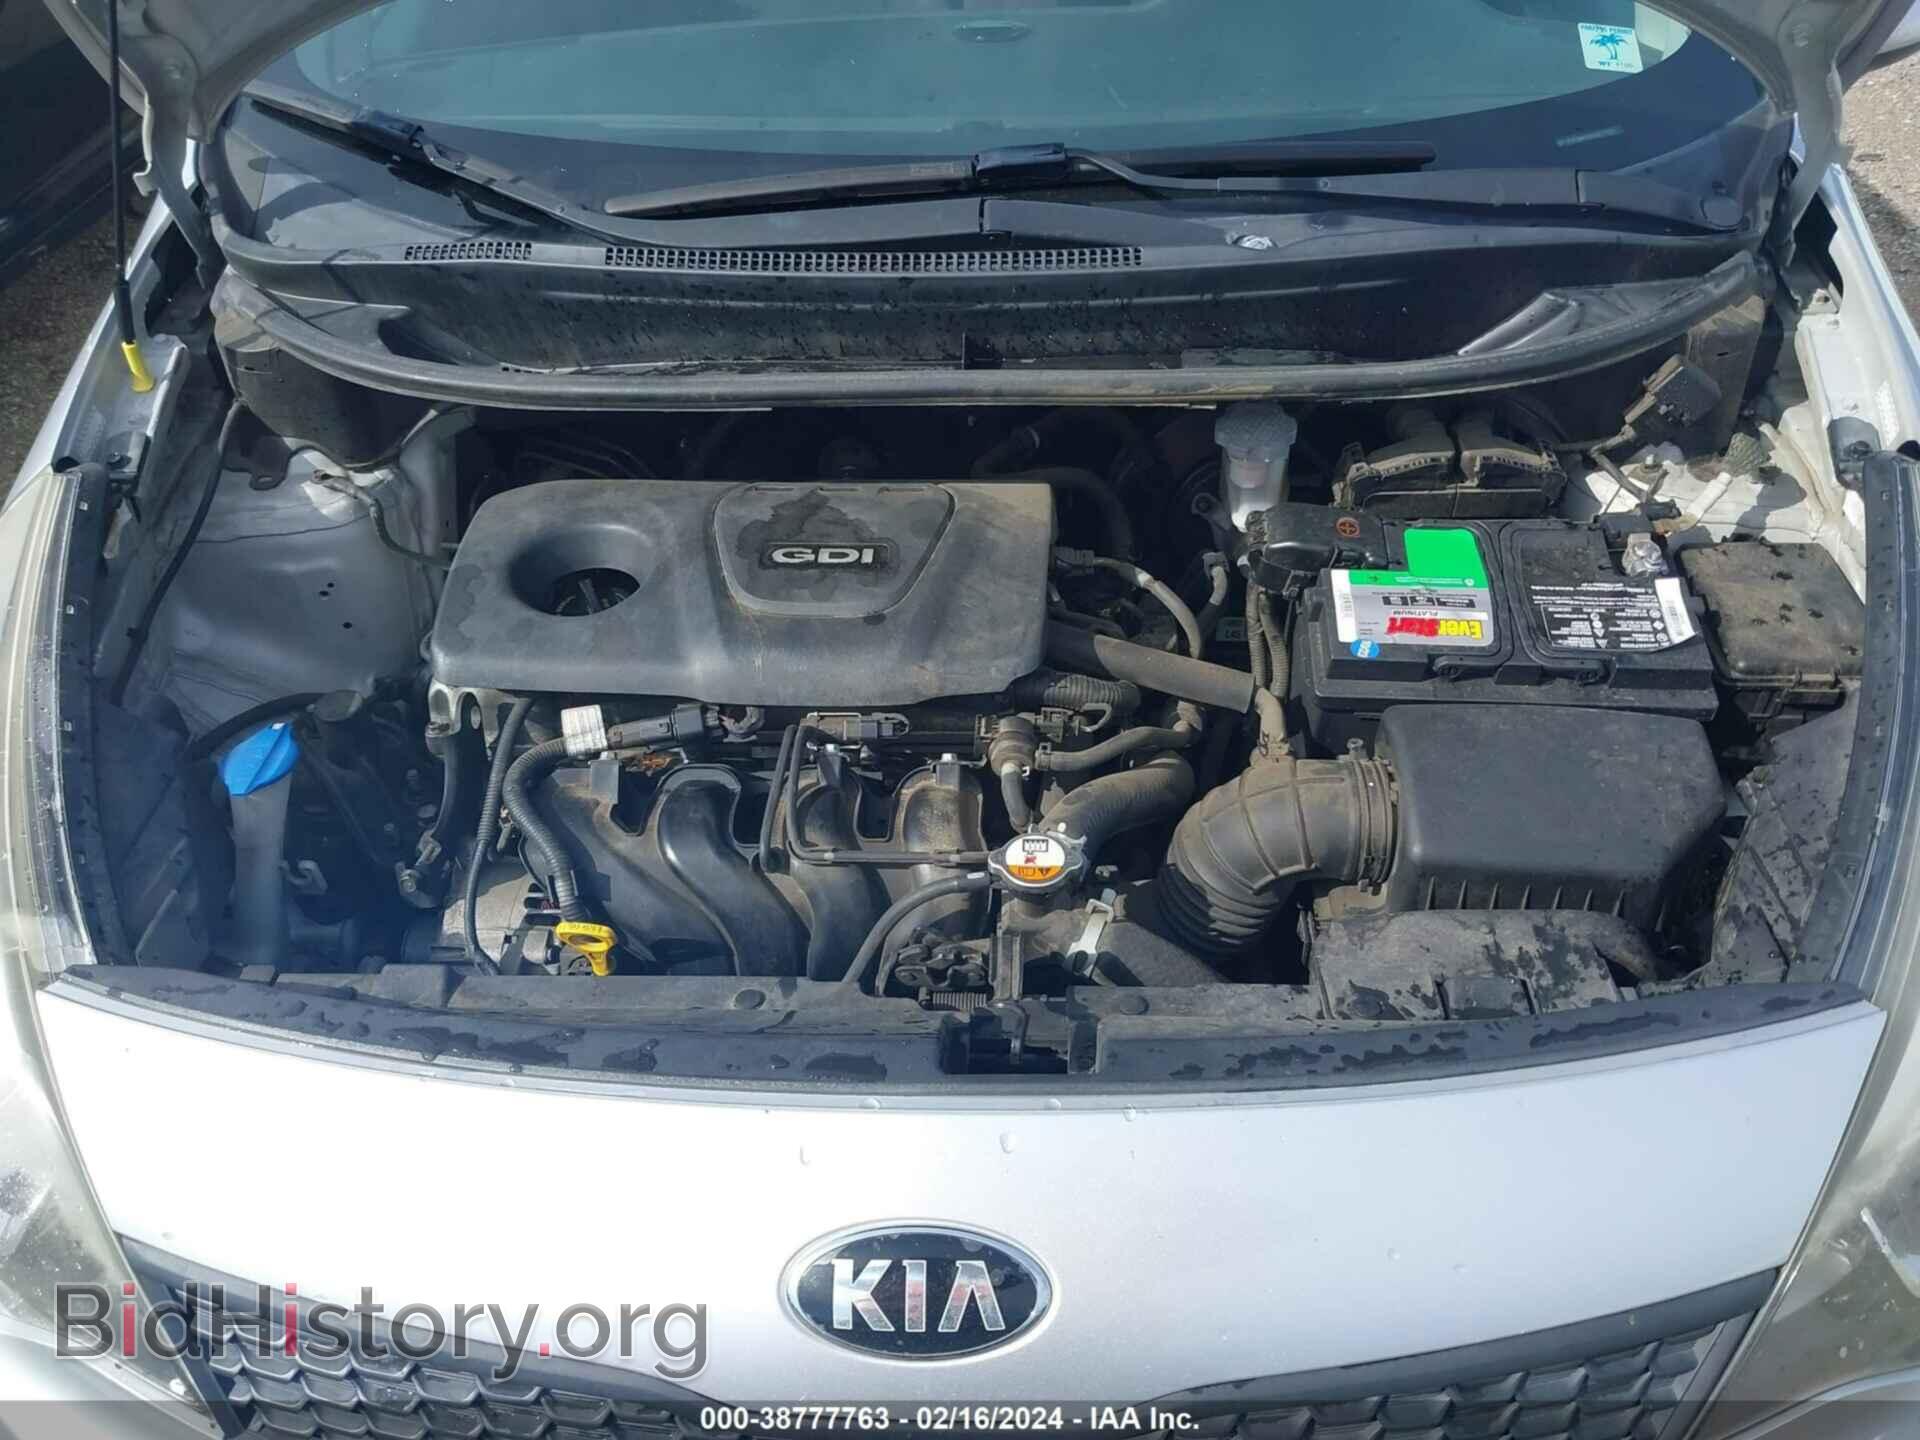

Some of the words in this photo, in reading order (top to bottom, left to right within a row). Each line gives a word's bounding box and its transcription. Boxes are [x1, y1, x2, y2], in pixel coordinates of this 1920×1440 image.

[771, 547, 875, 564] GDI
[1384, 616, 1484, 641] EverStart
[831, 1258, 1006, 1332] KIA
